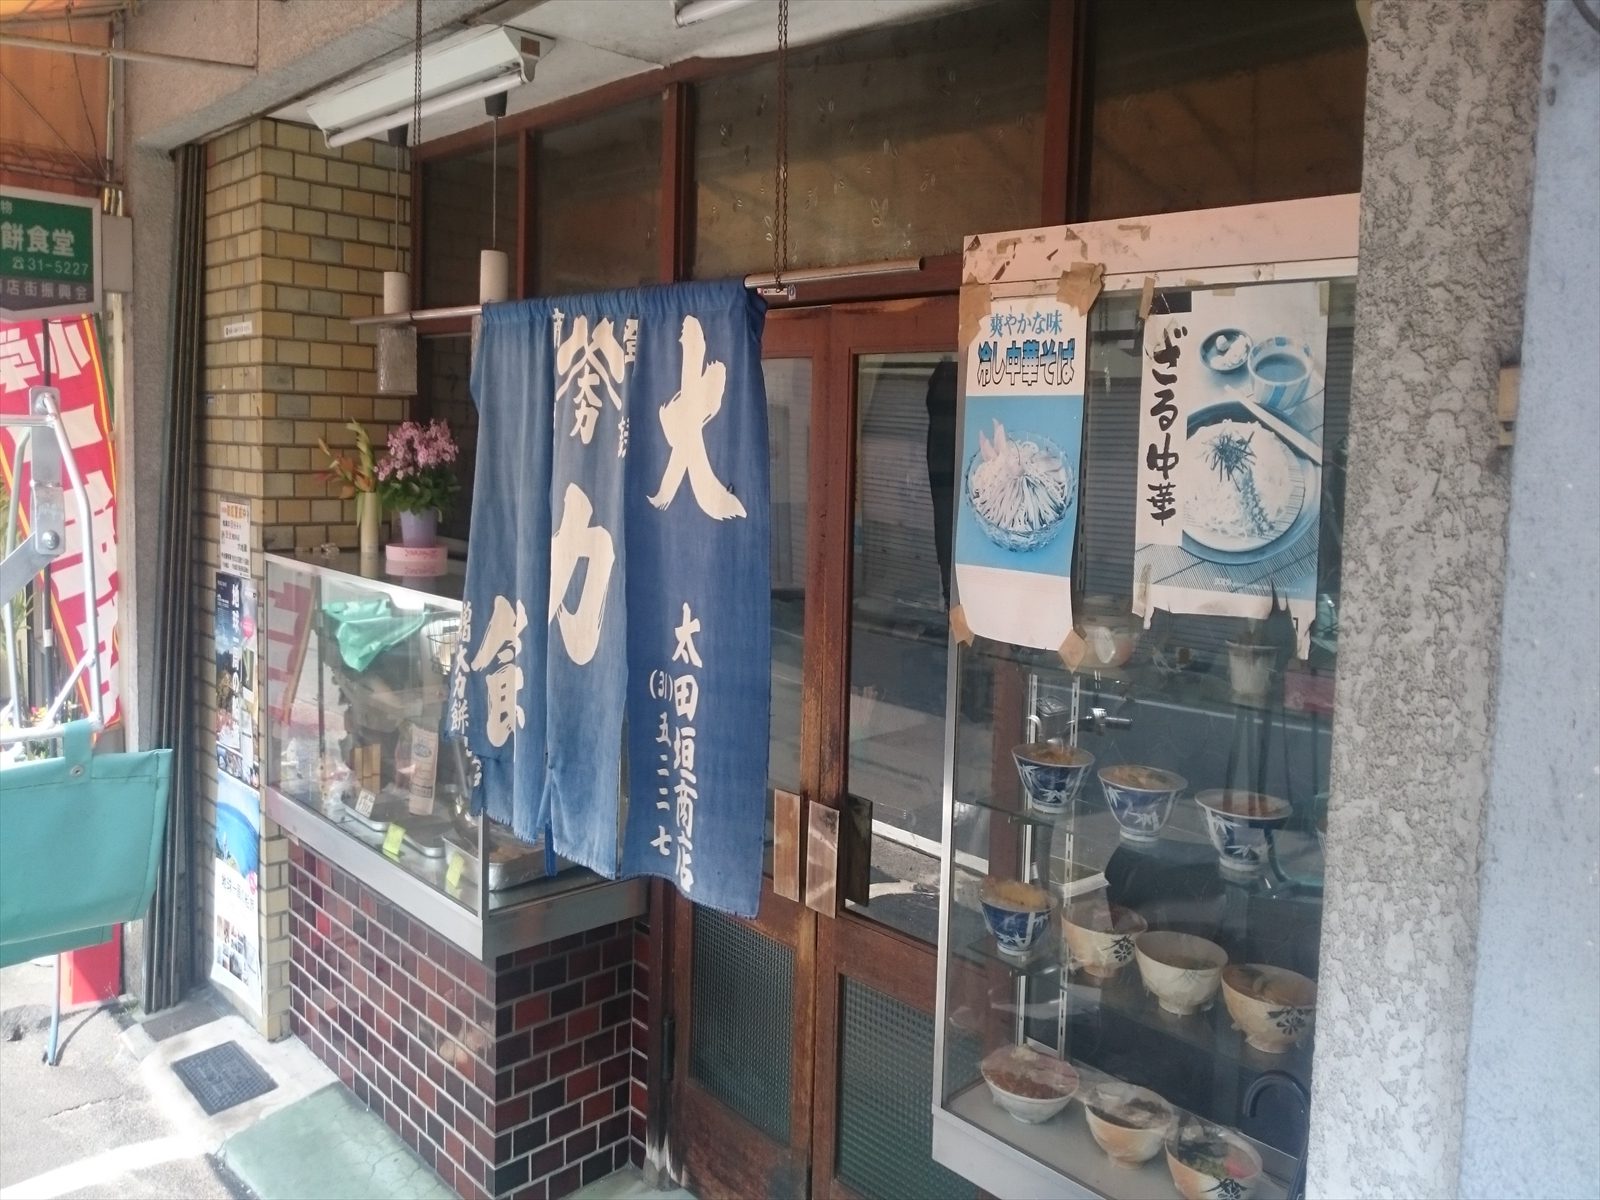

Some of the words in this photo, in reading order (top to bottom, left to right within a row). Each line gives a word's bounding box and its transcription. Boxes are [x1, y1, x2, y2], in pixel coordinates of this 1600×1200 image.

[0, 221, 75, 257] 餅食堂
[27, 258, 89, 276] 31-5227
[0, 279, 88, 301] 店街振興会
[990, 310, 1063, 338] 爽やかな味
[976, 338, 1077, 388] 冷し中華そば
[1146, 326, 1188, 527] ざる中華
[672, 602, 703, 893] 太田垣商店
